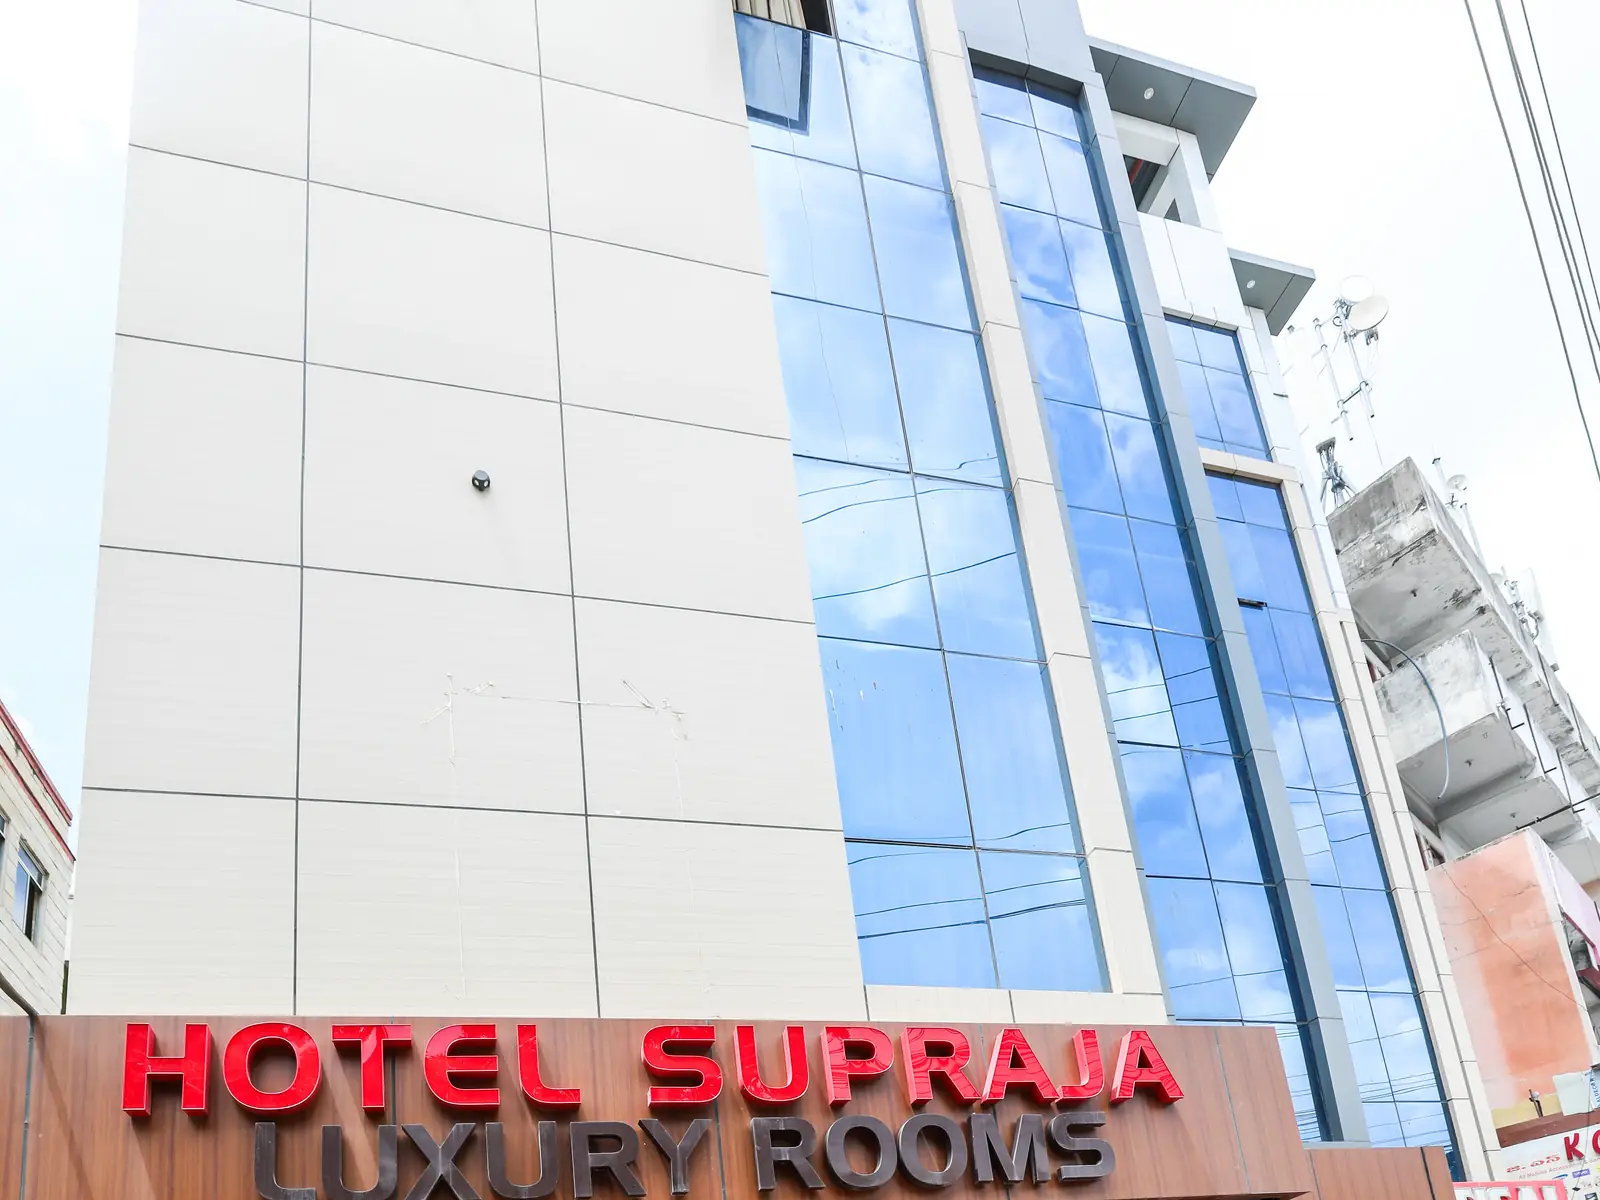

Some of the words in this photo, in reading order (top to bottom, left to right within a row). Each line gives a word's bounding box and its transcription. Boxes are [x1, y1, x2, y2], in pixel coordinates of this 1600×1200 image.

[121, 1021, 582, 1117] HOTEL
[640, 1024, 1185, 1108] SUPRAJA
[750, 1111, 1116, 1192] ROOMS
